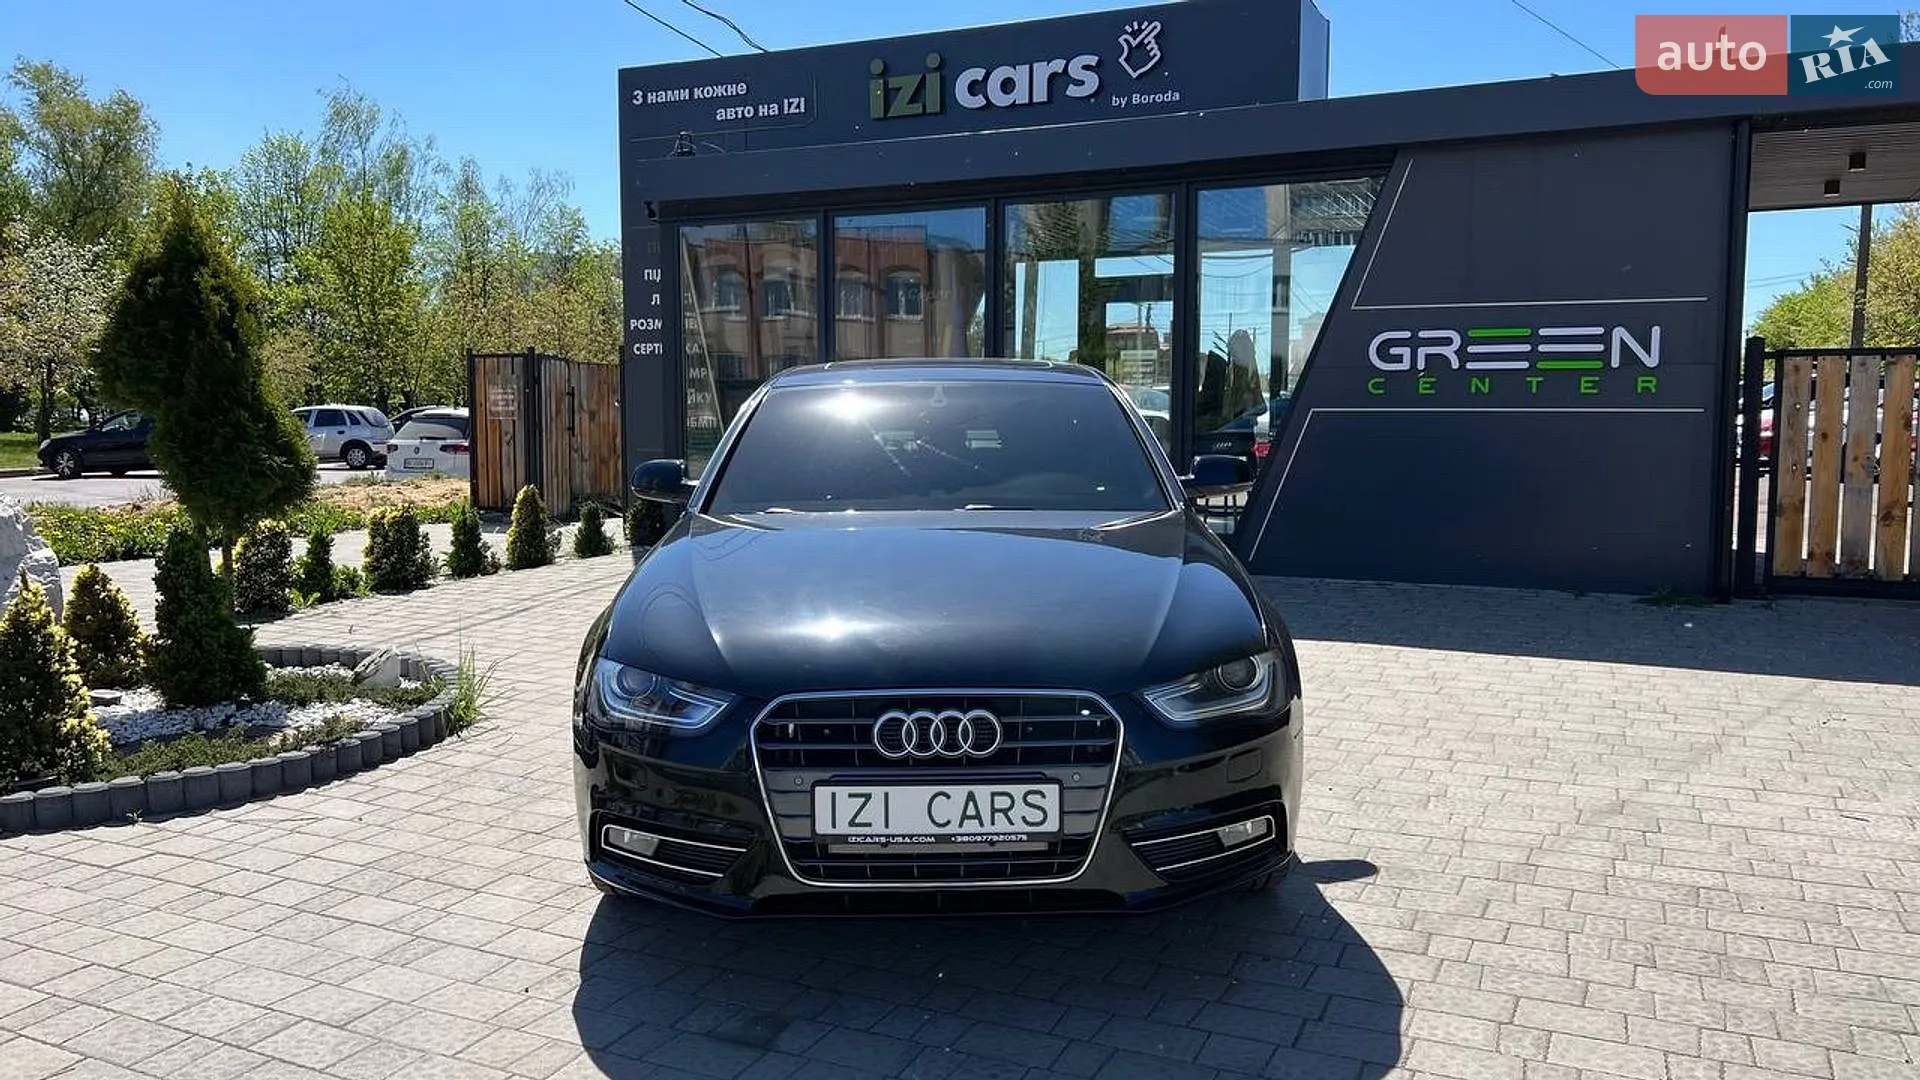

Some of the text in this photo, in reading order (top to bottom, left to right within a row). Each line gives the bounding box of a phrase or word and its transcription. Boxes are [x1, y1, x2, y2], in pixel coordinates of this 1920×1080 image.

[647, 87, 690, 104] нами
[693, 82, 747, 100] кожне
[868, 51, 1101, 120] izi cars
[716, 97, 806, 121] авто на IZI
[1111, 90, 1180, 108] by Boroda
[1368, 325, 1661, 371] GREEN
[1368, 376, 1657, 395] CENTER
[831, 789, 1049, 829] IZI CARS
